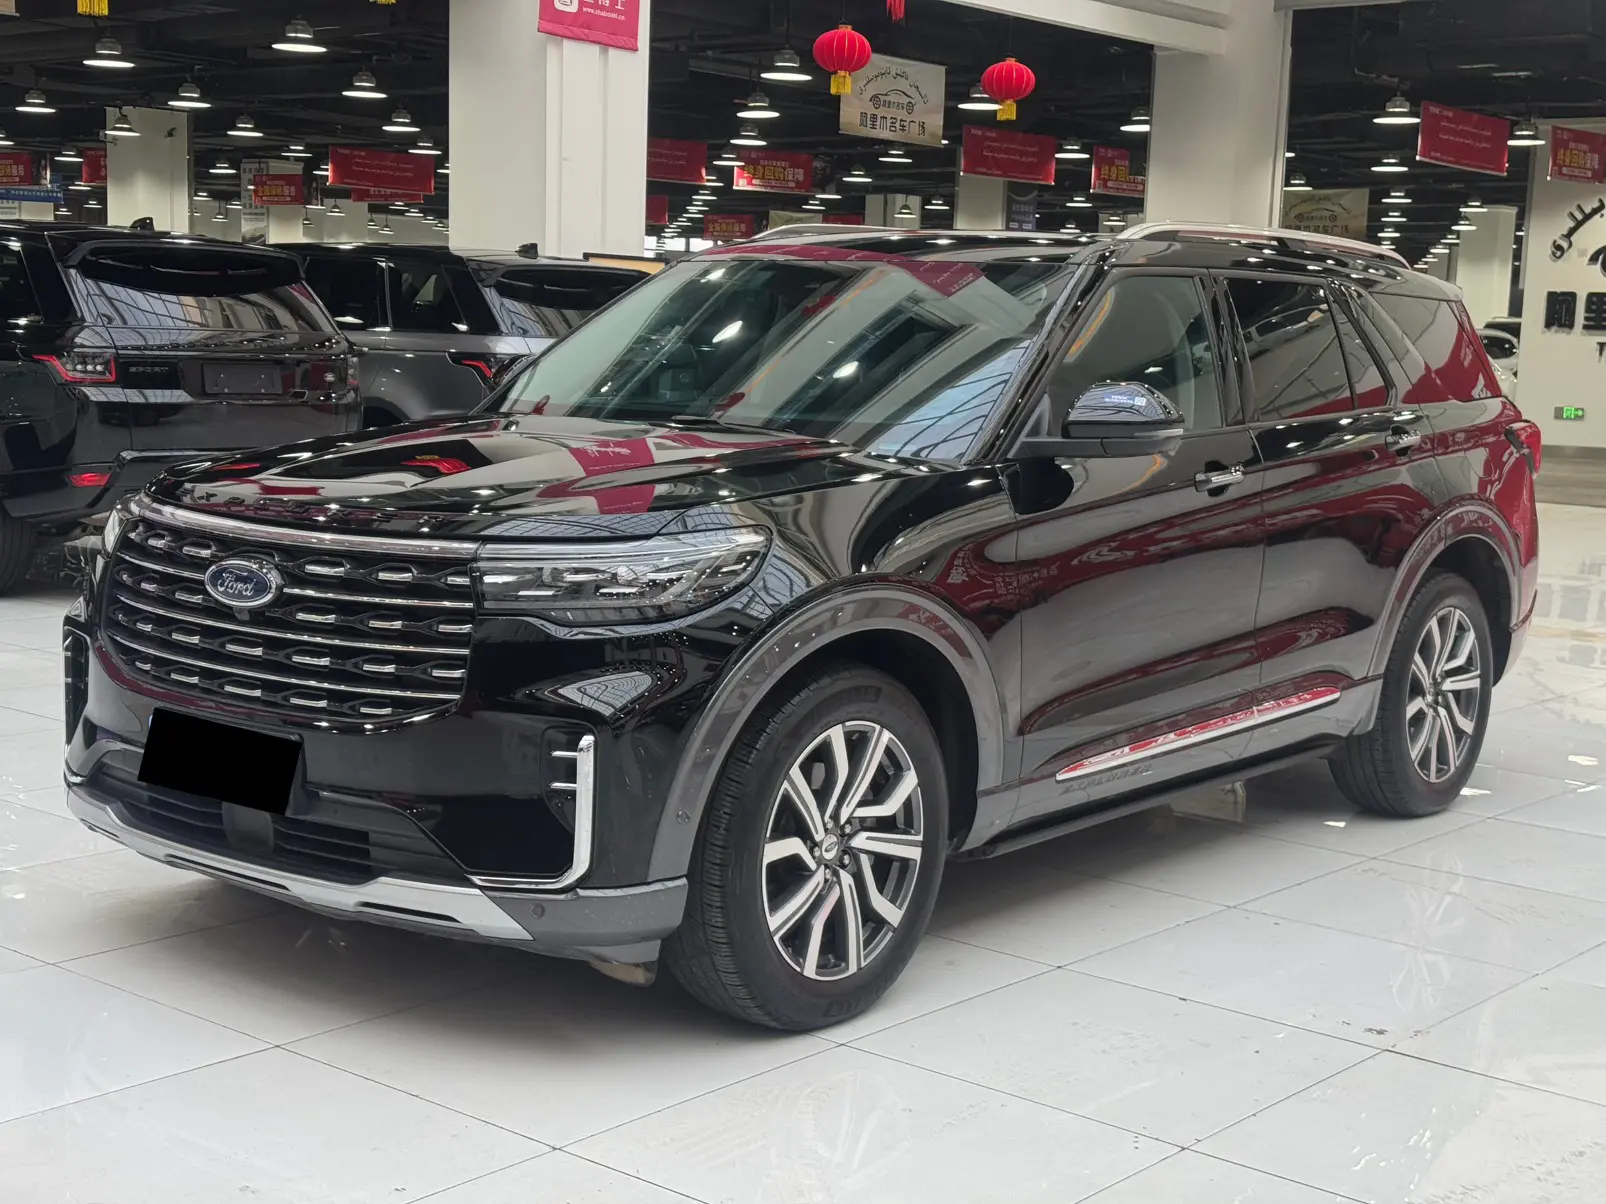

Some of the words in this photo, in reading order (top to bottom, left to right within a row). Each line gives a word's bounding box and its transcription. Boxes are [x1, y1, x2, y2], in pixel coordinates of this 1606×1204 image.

[582, 6, 626, 20] www.chaboshi.cn
[859, 111, 926, 137] 阿里木名车广场
[217, 568, 257, 597] Ford
